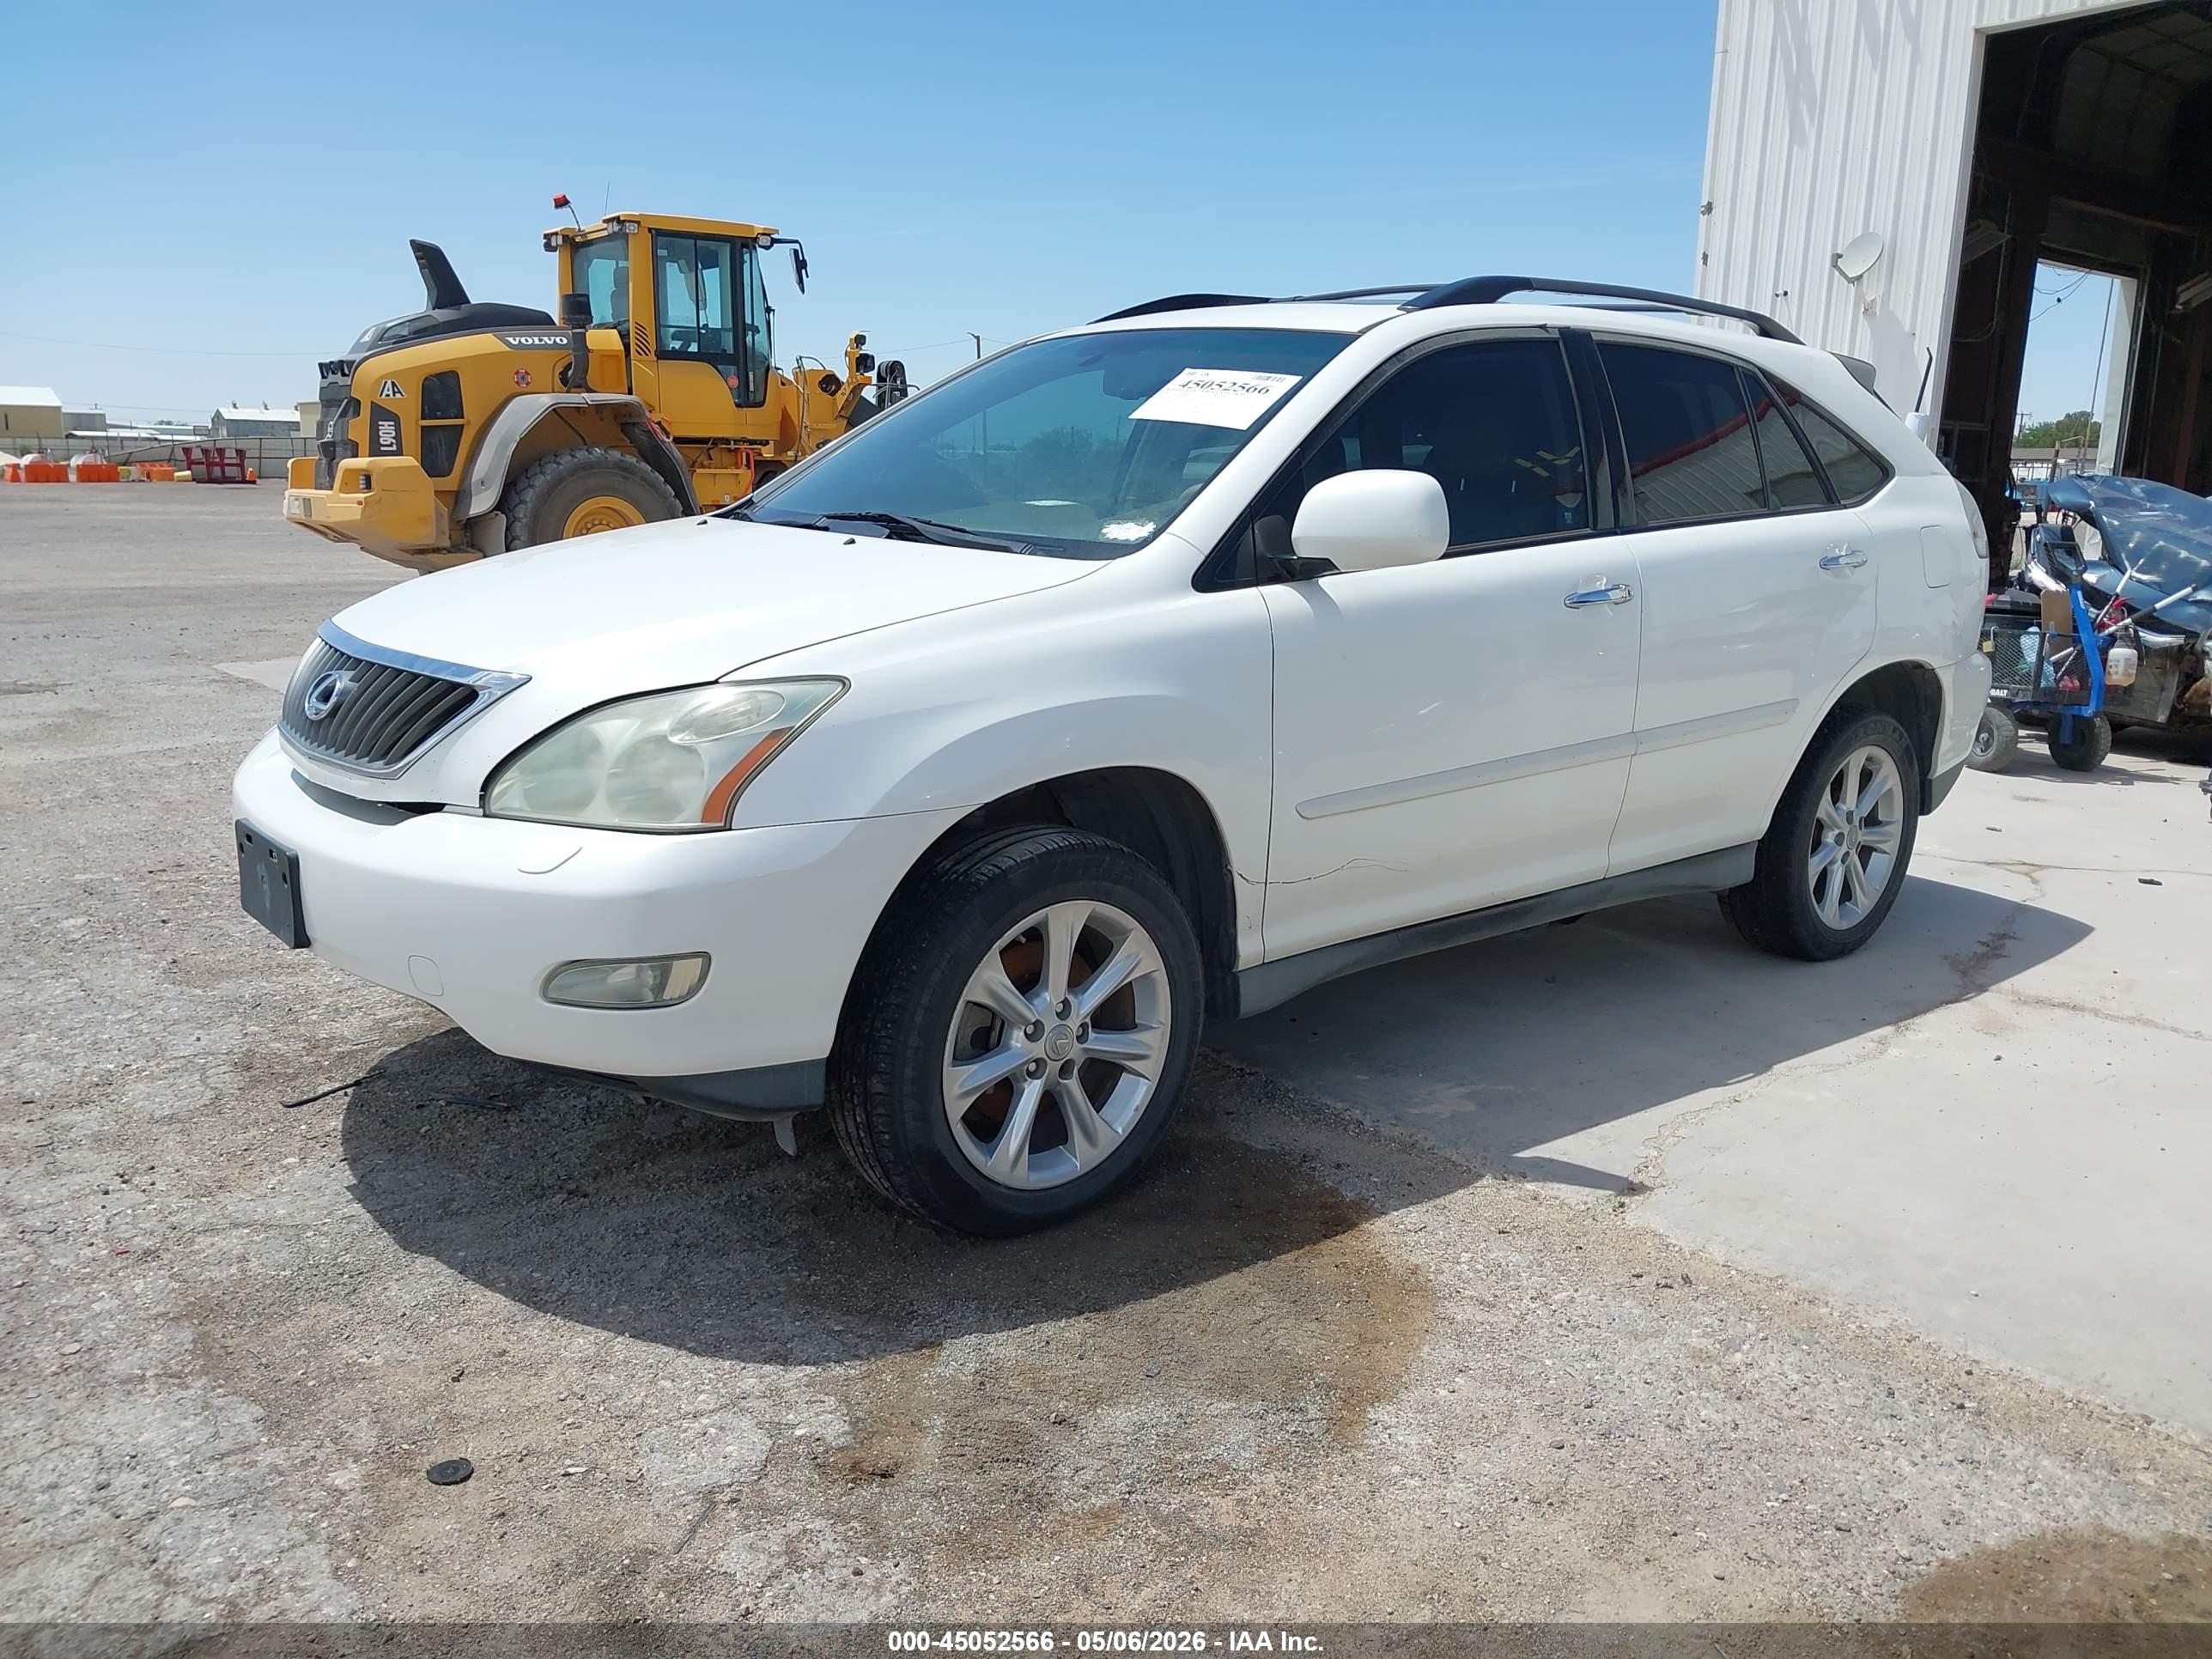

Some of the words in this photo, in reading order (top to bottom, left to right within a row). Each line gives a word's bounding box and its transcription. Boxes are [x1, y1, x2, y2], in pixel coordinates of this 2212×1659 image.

[504, 336, 568, 345] VOLVO
[1178, 380, 1271, 395] 45052566
[378, 421, 398, 451] L90H
